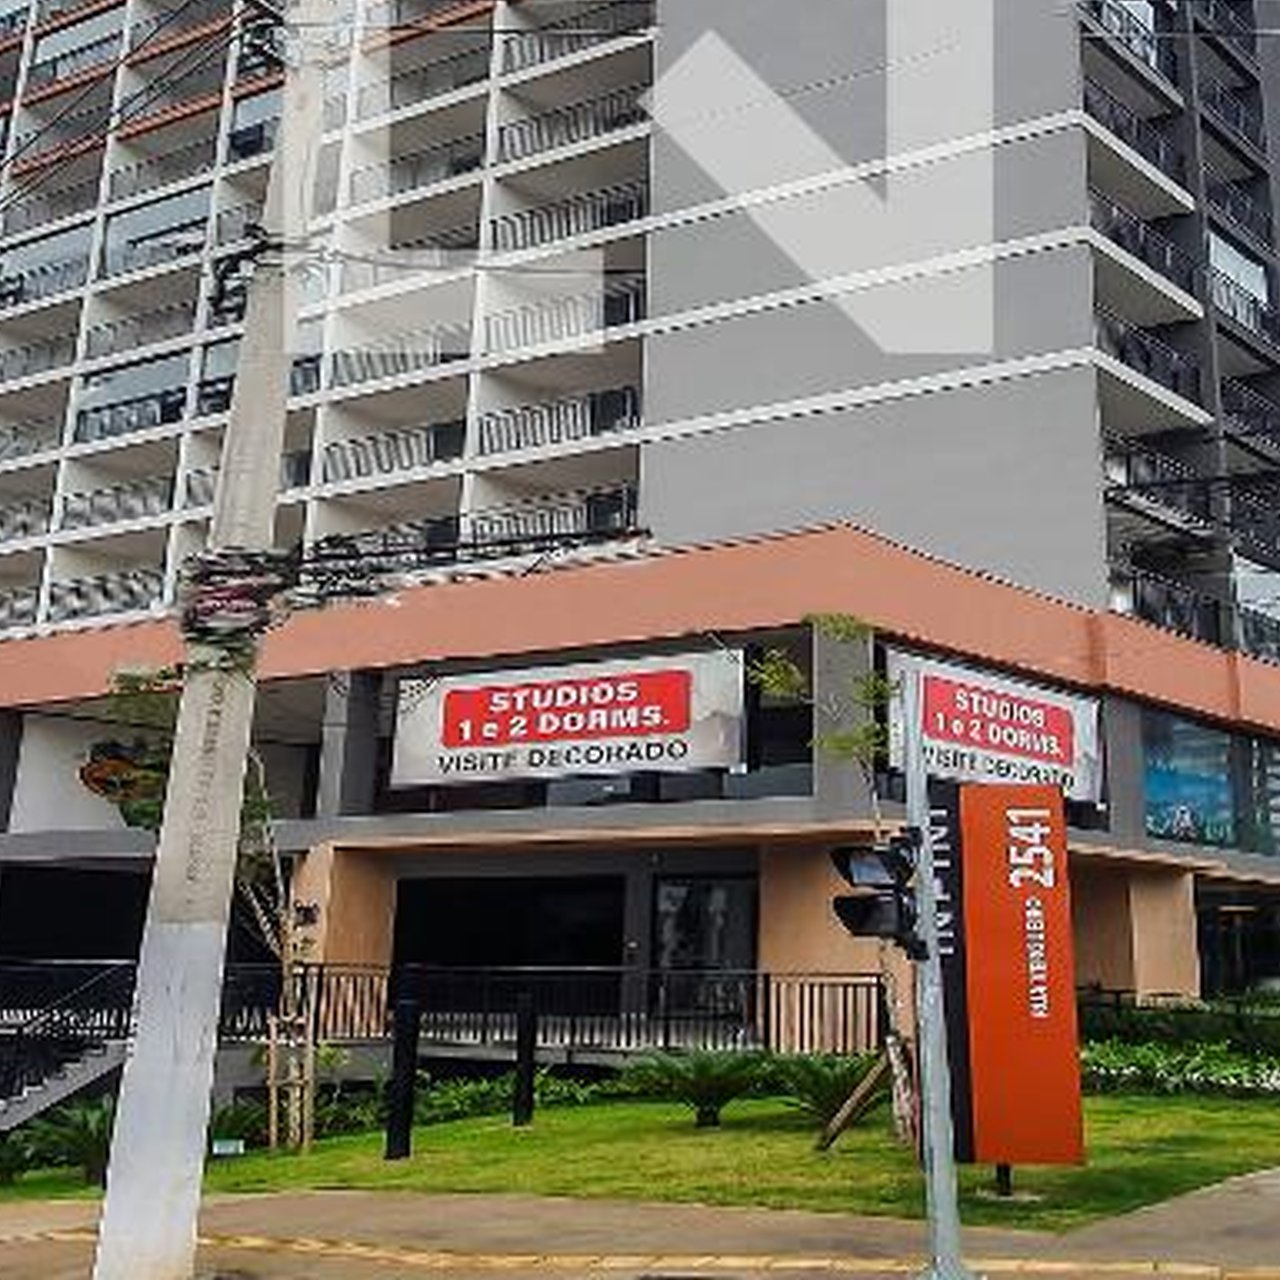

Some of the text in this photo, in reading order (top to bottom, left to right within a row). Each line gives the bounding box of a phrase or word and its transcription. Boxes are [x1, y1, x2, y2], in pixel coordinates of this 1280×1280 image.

[489, 682, 638, 713] STUDIOS
[955, 689, 1045, 727] STUDIOS
[459, 721, 470, 741] 1
[509, 716, 528, 737] 2
[538, 704, 670, 734] DORMS.
[935, 713, 945, 731] 1
[969, 719, 981, 740] 2
[439, 739, 688, 774] VISITE DECORADO
[1006, 807, 1055, 889] 2541
